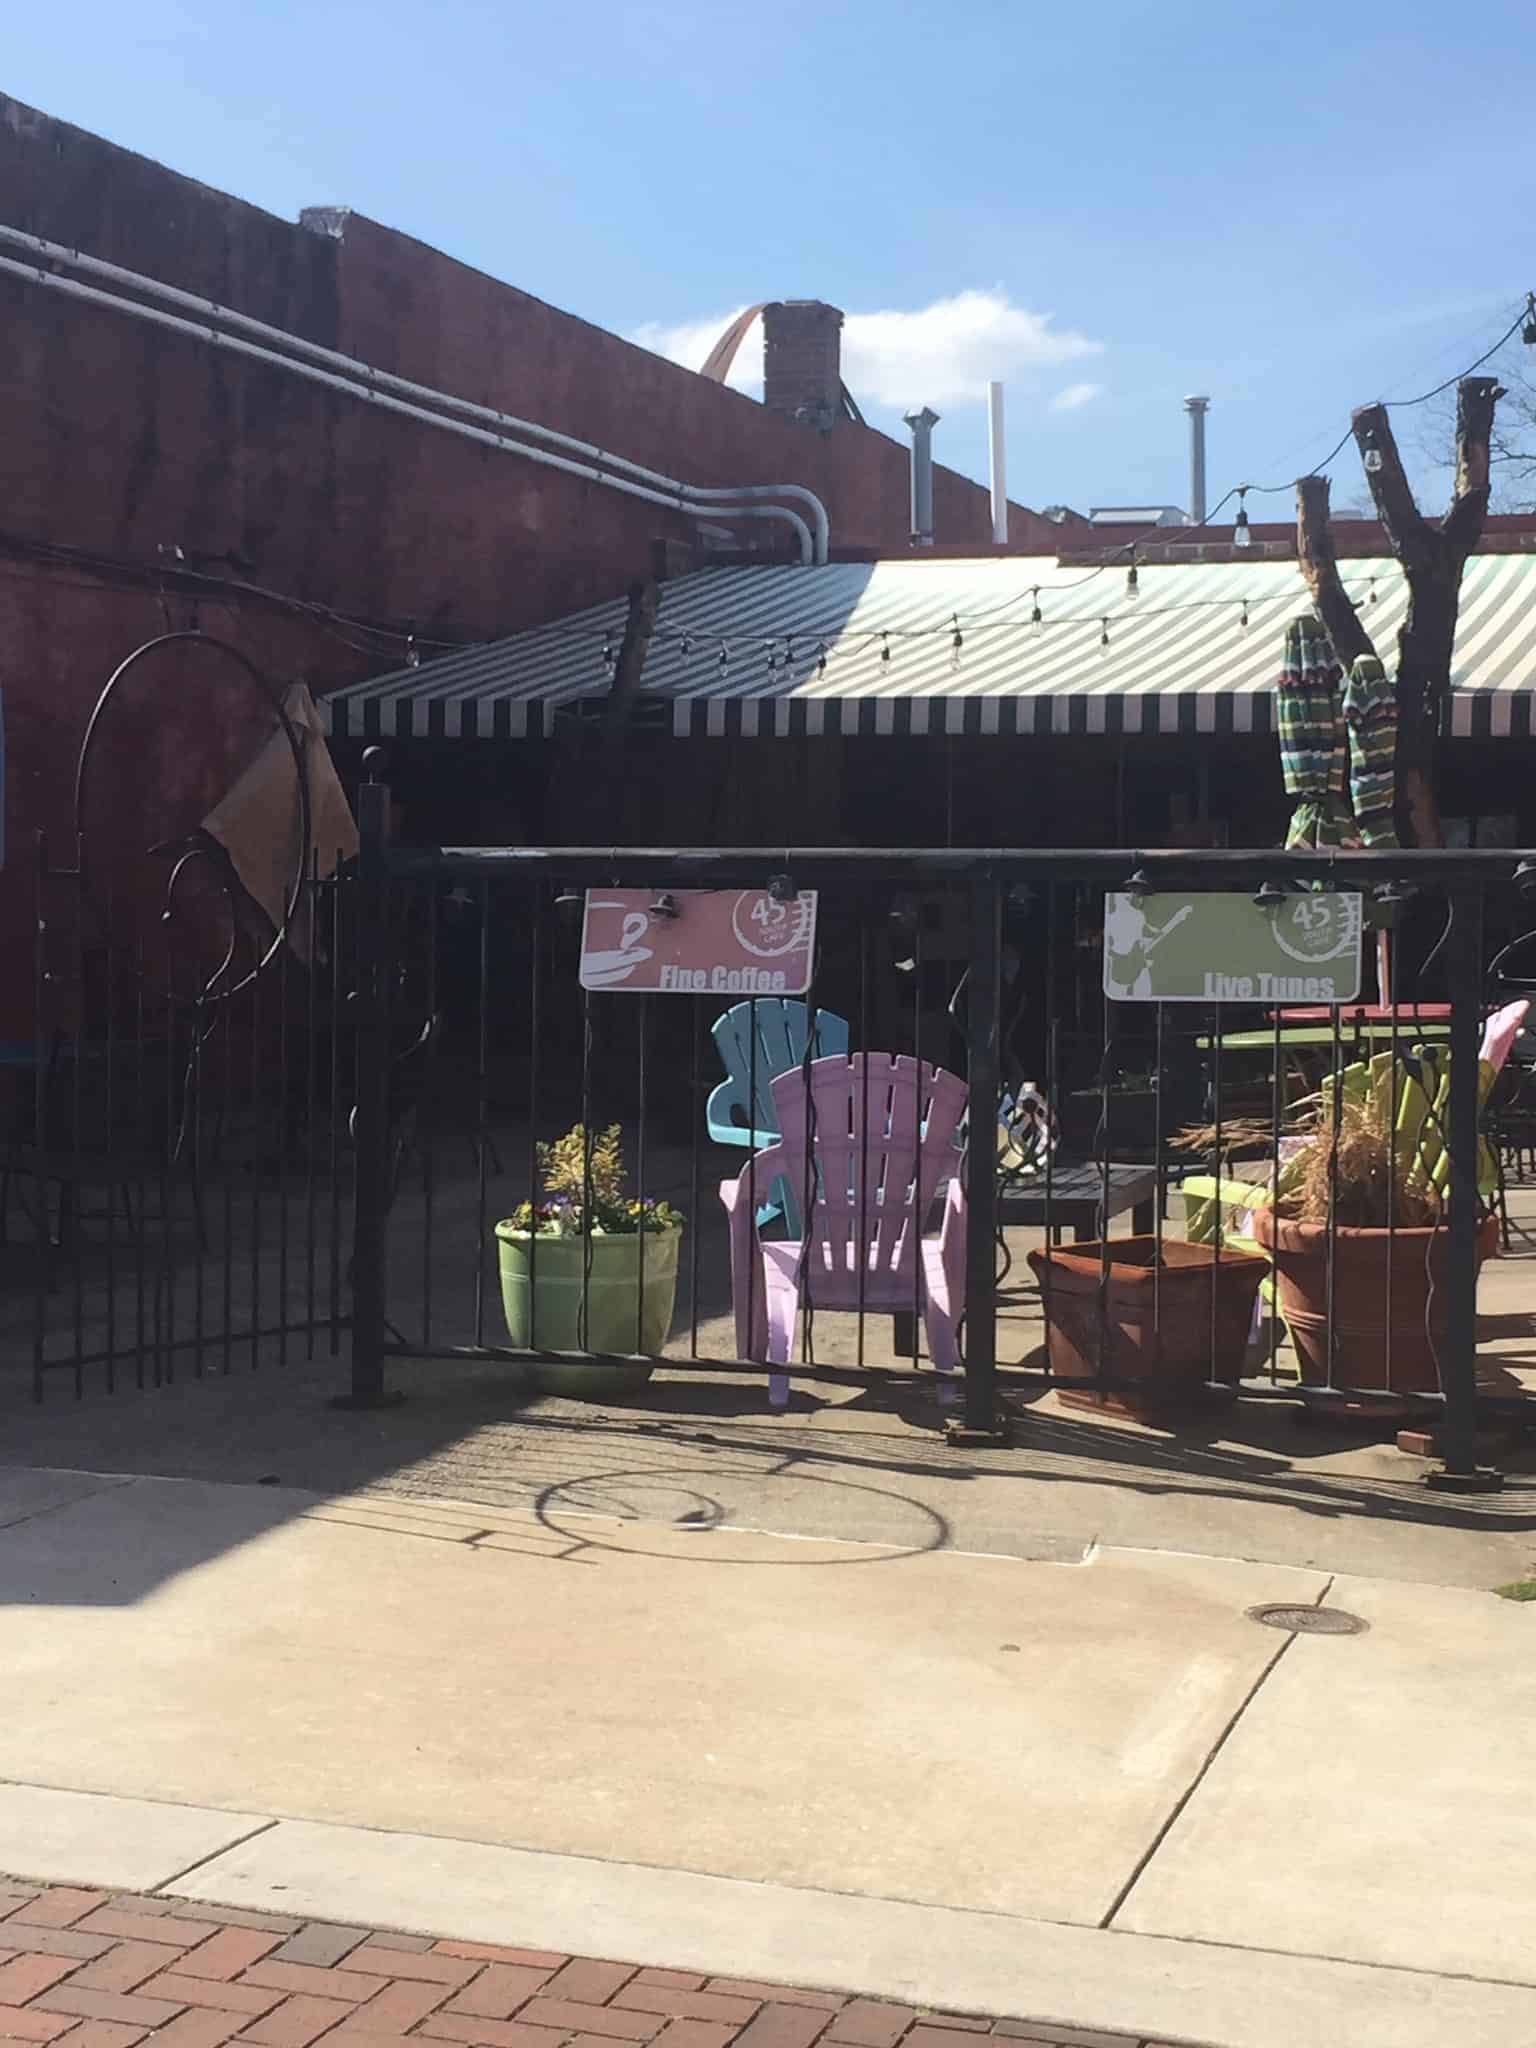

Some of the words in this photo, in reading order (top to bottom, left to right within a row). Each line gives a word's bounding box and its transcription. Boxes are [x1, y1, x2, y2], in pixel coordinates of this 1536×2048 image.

[751, 896, 787, 927] 45
[1292, 896, 1331, 930] 45
[660, 964, 707, 990] Fine
[711, 965, 786, 992] Coffee
[1203, 972, 1253, 998] Live
[1256, 972, 1335, 999] Tunes
